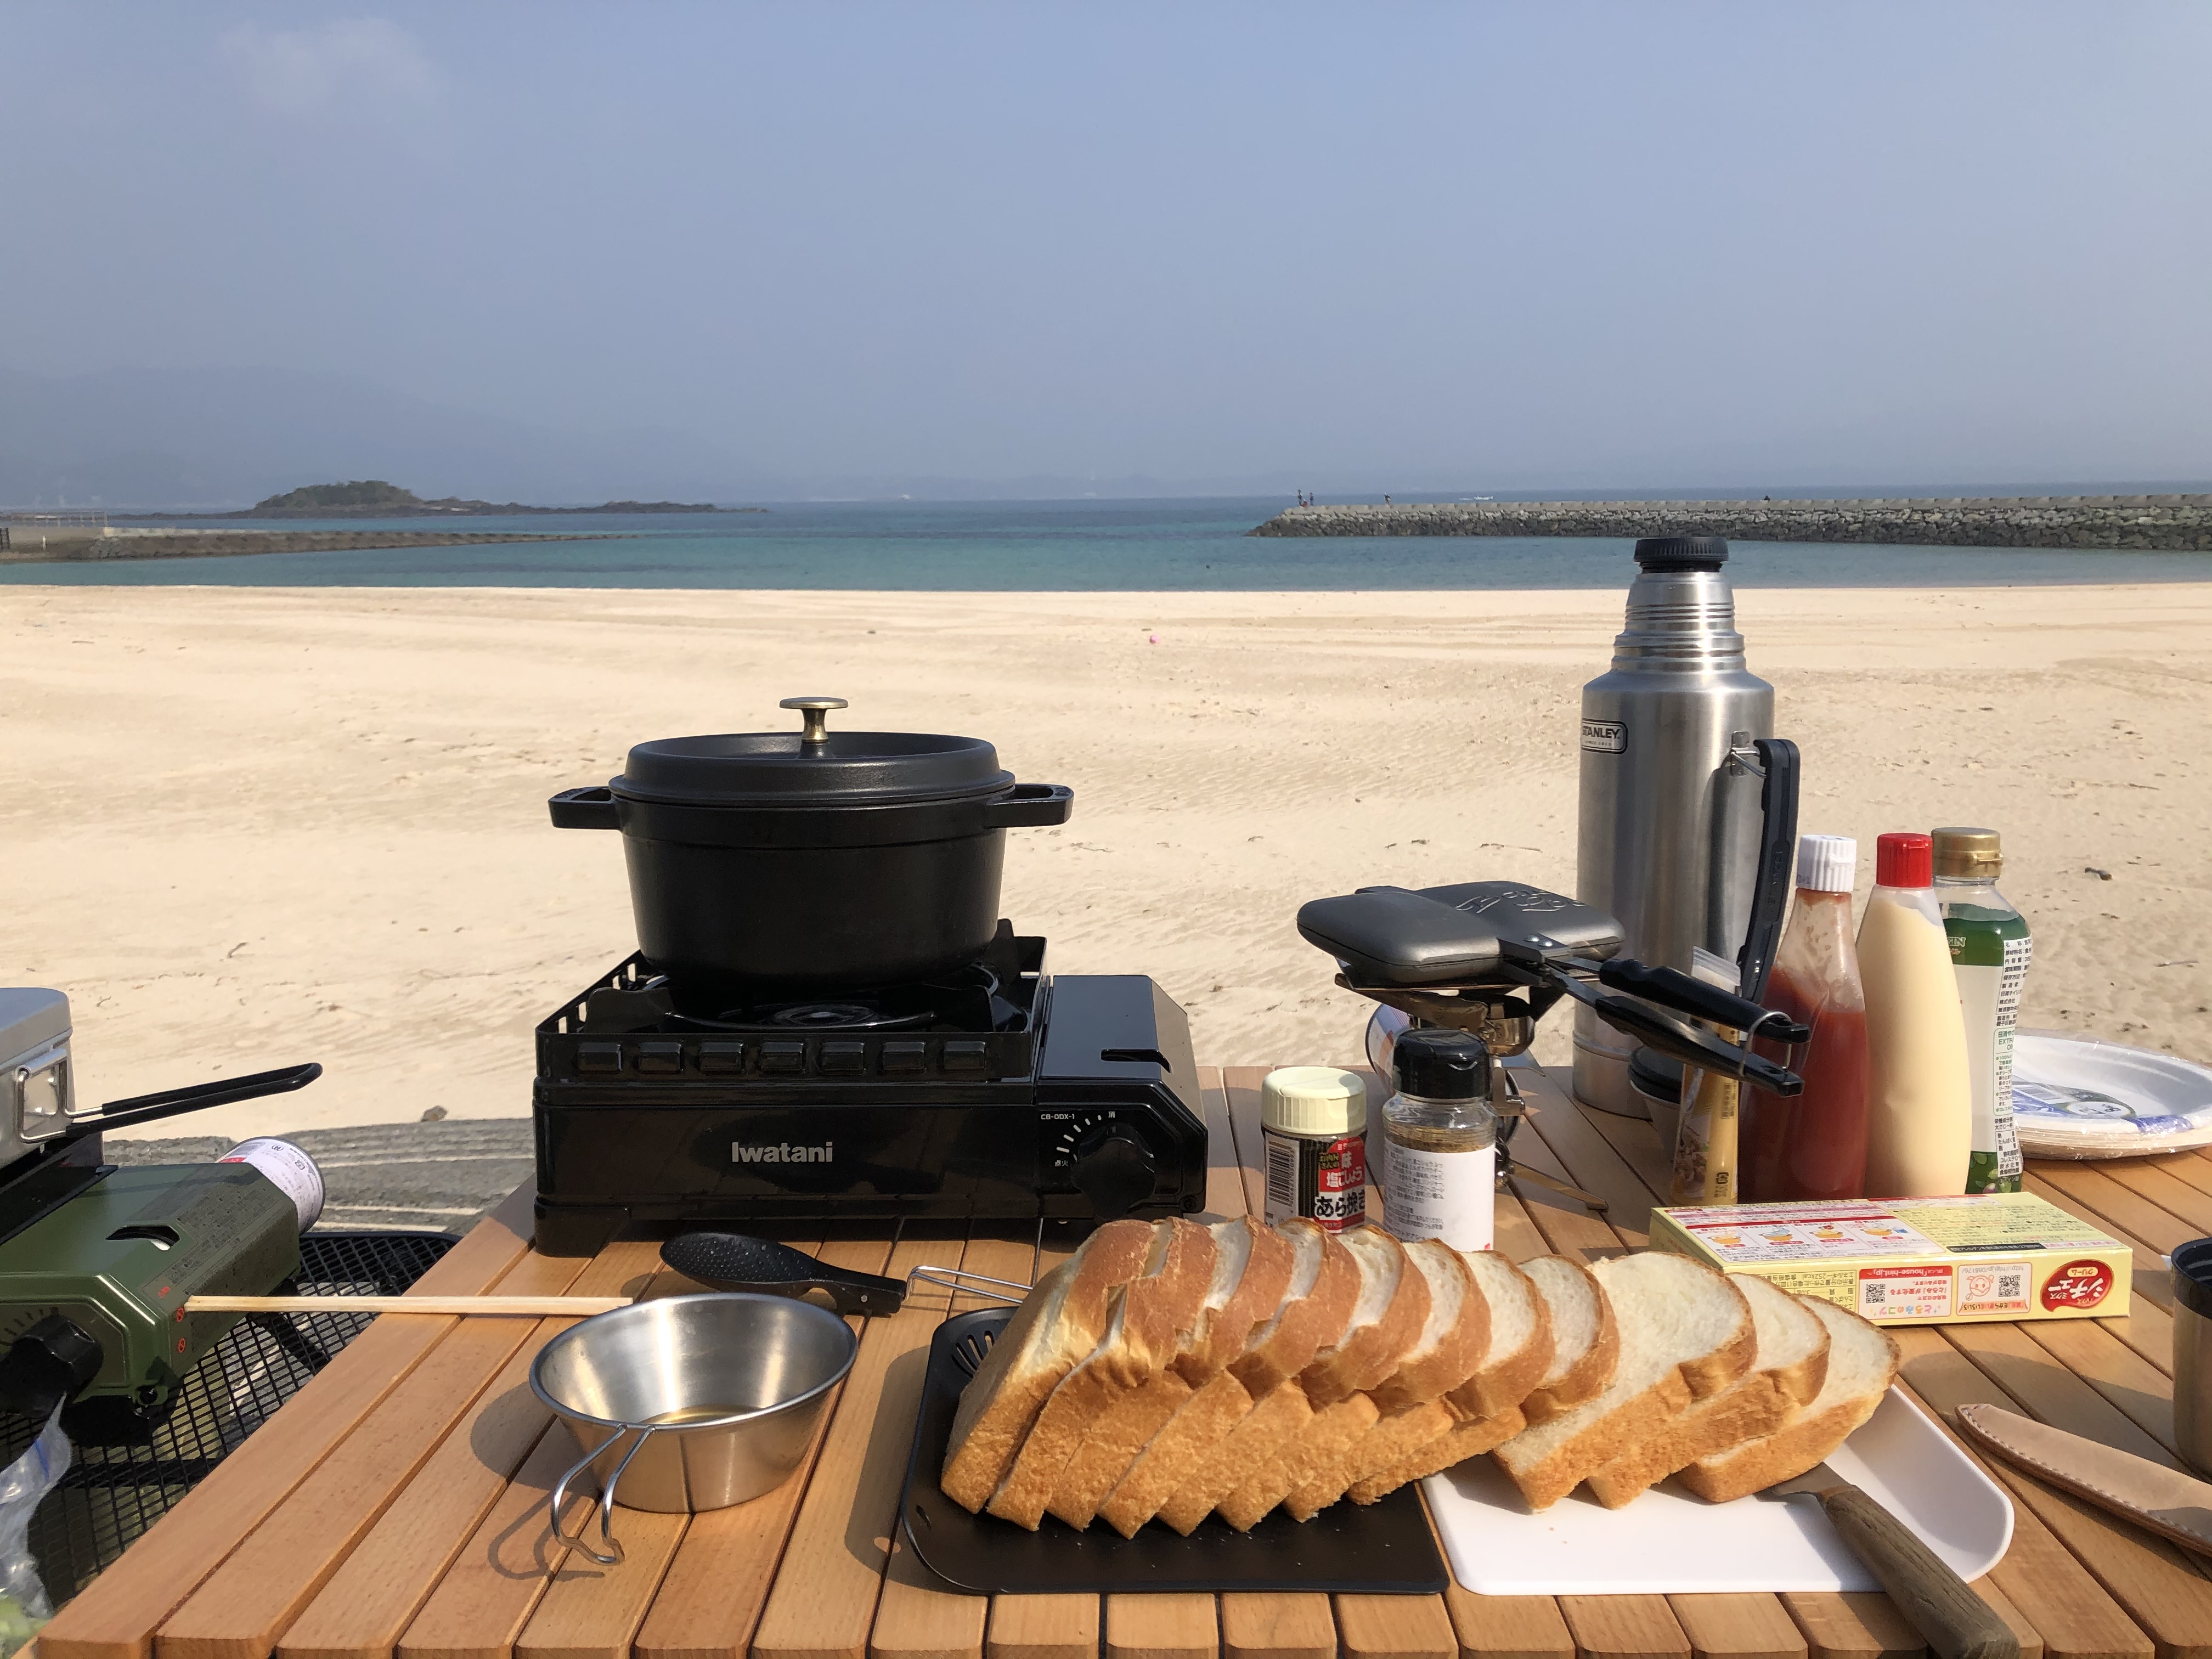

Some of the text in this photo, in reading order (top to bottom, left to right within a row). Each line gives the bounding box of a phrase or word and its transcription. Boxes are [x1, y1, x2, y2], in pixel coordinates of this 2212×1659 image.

[732, 1142, 833, 1162] Iwatani
[1327, 1166, 1363, 1187] 塩こしょう
[2048, 1278, 2104, 1299] シチュー
[1879, 1305, 1932, 1316] とろみのコツ
